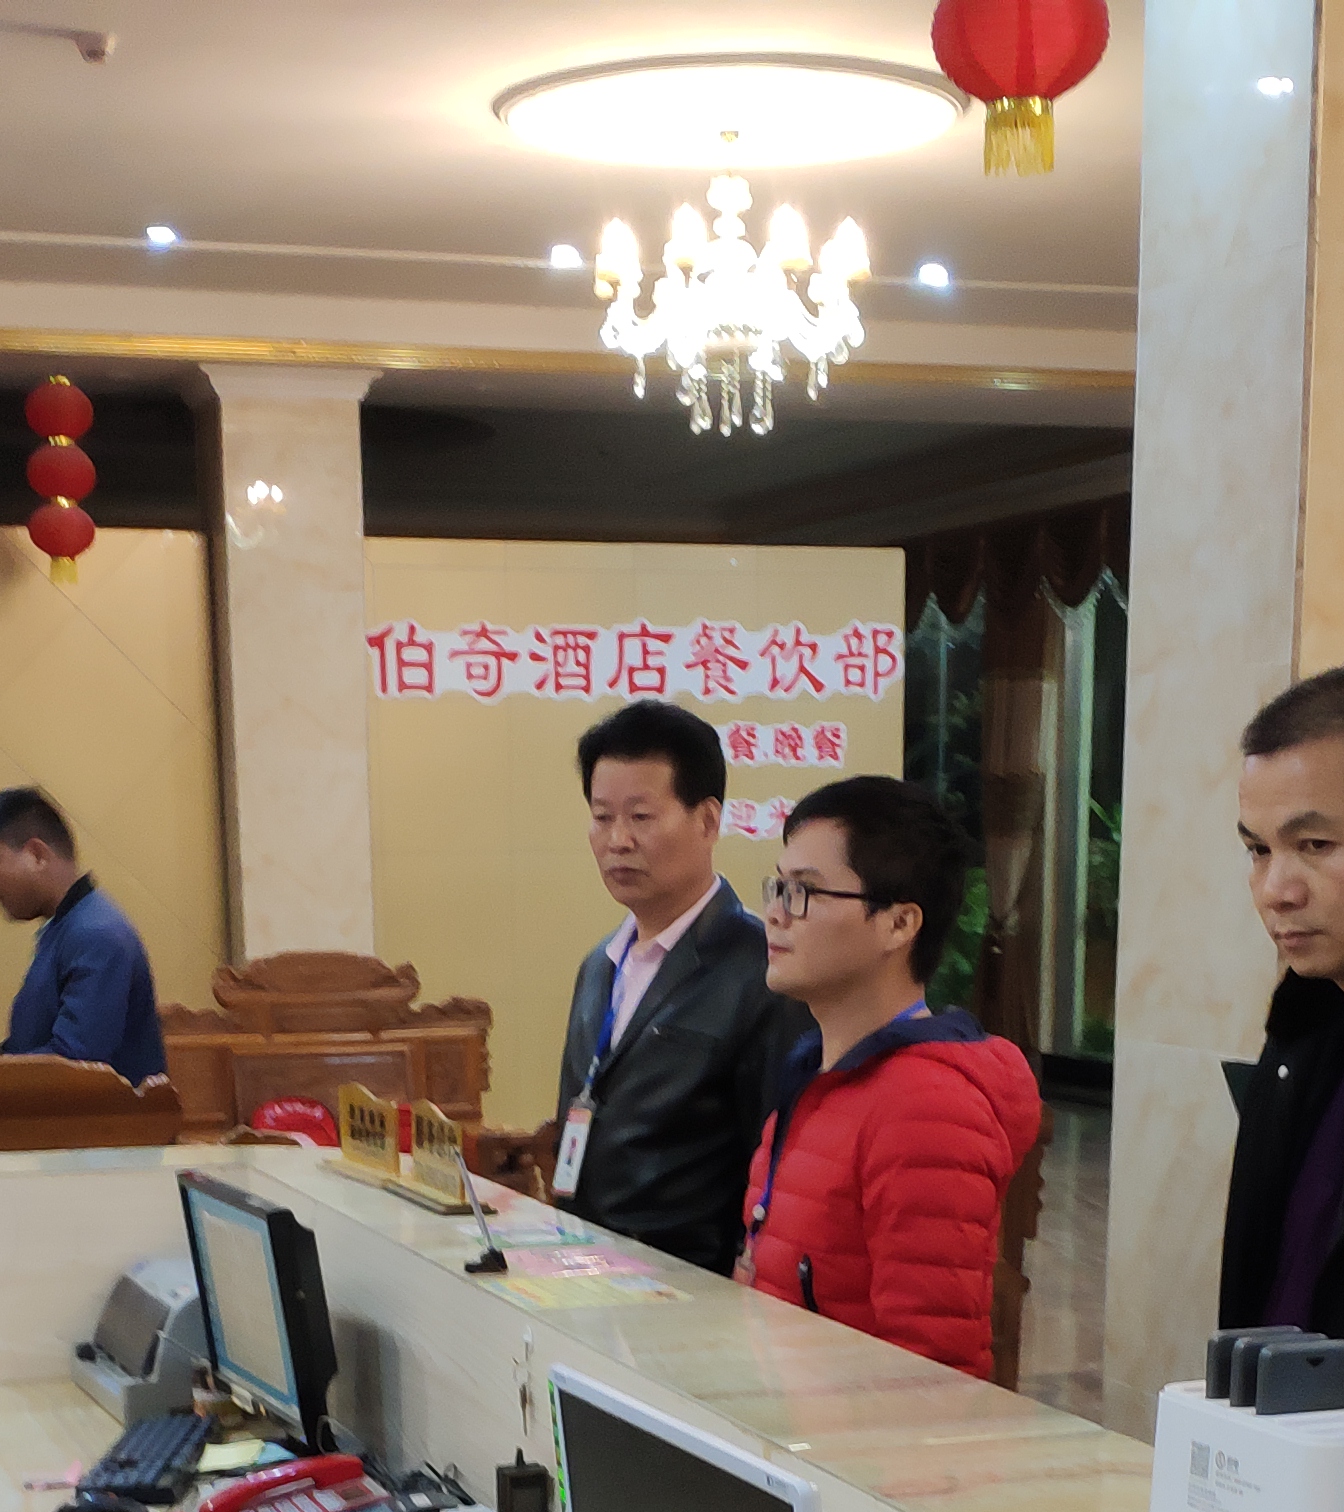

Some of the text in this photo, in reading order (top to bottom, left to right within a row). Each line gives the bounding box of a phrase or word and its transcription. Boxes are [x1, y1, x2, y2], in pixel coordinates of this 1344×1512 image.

[364, 621, 899, 698] 伯奇酒店餐饮部
